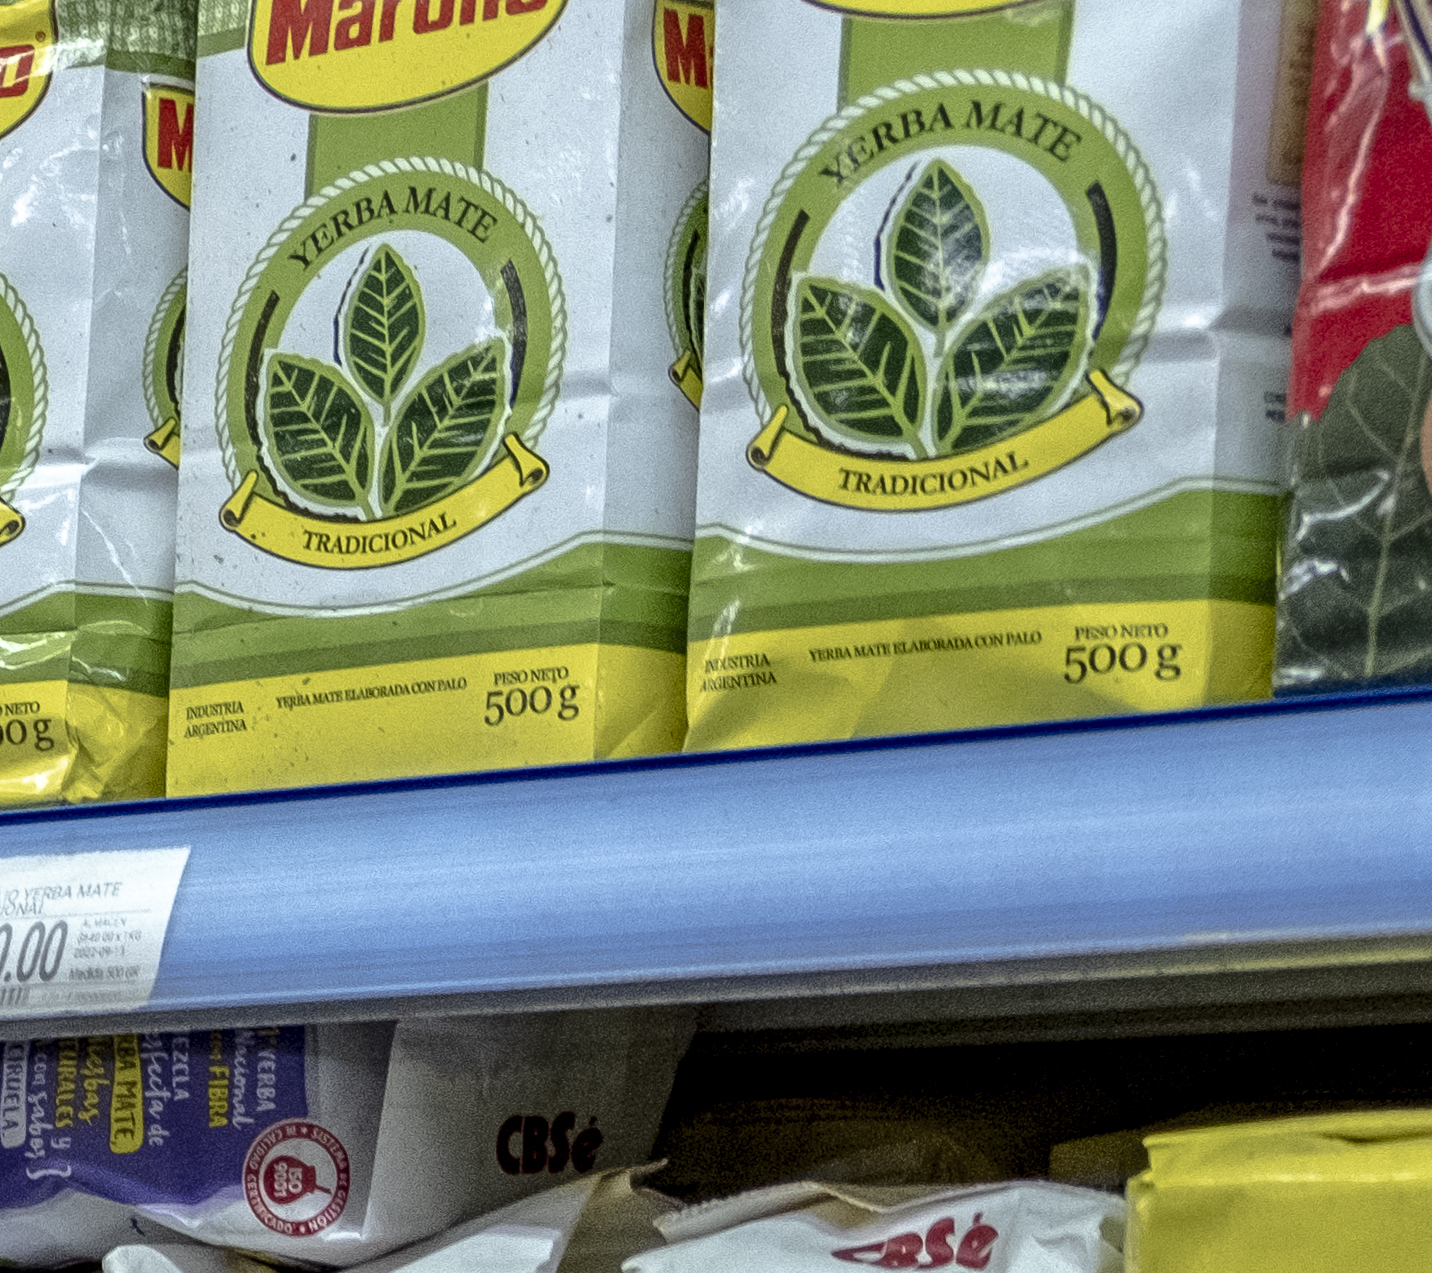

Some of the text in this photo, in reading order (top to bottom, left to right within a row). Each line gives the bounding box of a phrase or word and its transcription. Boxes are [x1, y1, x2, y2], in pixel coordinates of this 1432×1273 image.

[818, 99, 1083, 191] YERBA MATE
[288, 186, 498, 274] YERBA MATE
[837, 451, 1030, 499] TRADICIONAL
[302, 513, 458, 556] TRADICIONAL
[184, 719, 248, 738] ARGENTINA
[185, 701, 245, 720] INDUSTRIA
[77, 881, 122, 899] MATE
